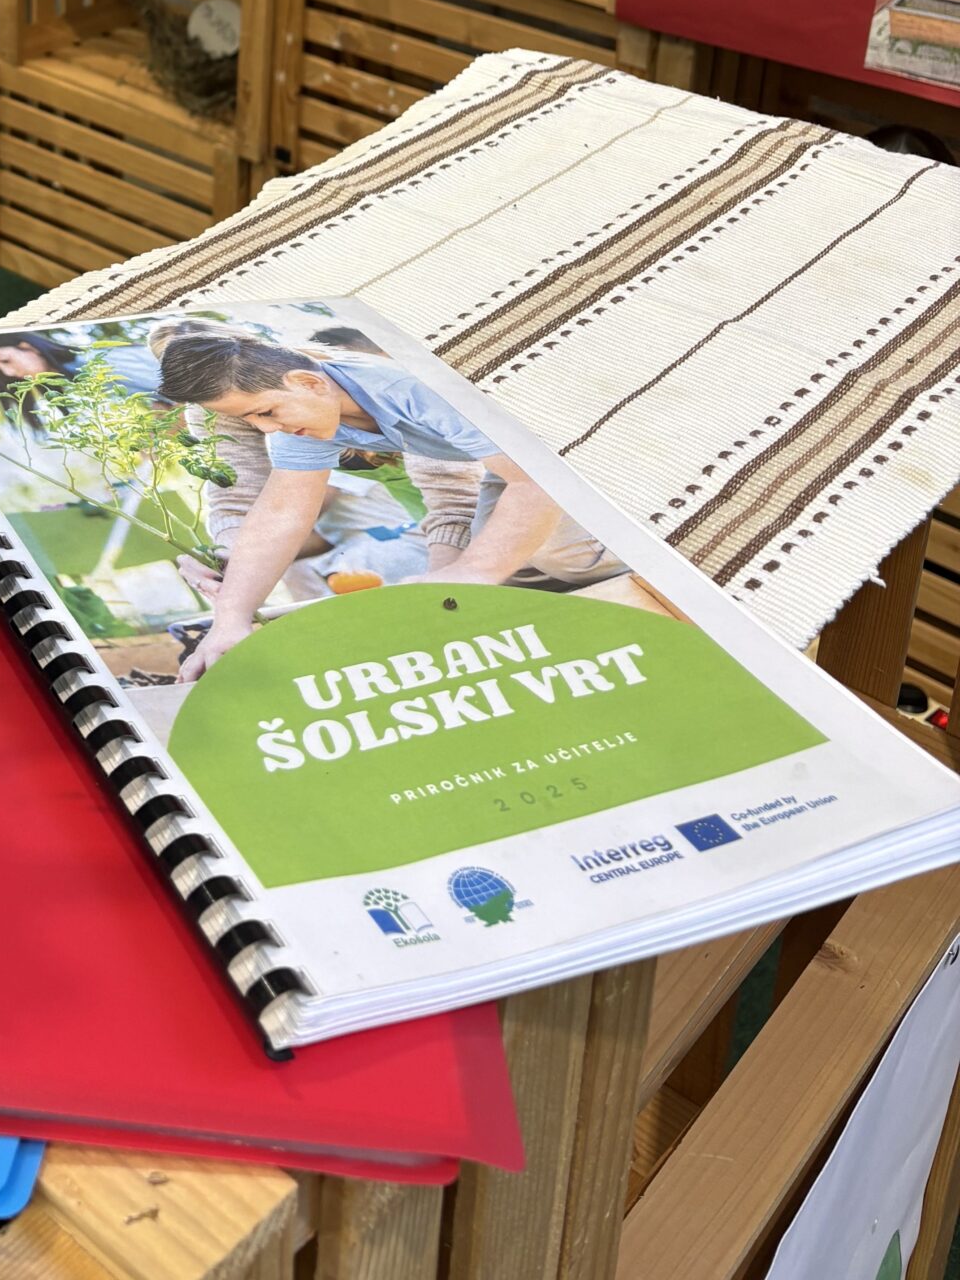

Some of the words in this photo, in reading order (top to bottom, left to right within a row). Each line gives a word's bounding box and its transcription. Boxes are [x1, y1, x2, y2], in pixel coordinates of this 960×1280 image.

[292, 623, 552, 710] URBANI
[256, 678, 515, 773] ŠOLSKI
[511, 643, 648, 704] VRT
[390, 766, 508, 805] PRIROČNIK
[511, 758, 540, 774] ZA
[544, 730, 639, 765] UČITELJE
[493, 776, 589, 813] 2025
[730, 797, 783, 821] Co-funded
[783, 793, 798, 807] by
[741, 819, 760, 832] the
[760, 804, 808, 827] European
[809, 793, 838, 810] Union
[570, 833, 674, 873] Interreg
[589, 865, 640, 885] CENTRAL
[640, 850, 685, 871] EUROPE
[392, 932, 442, 948] Ekošola
